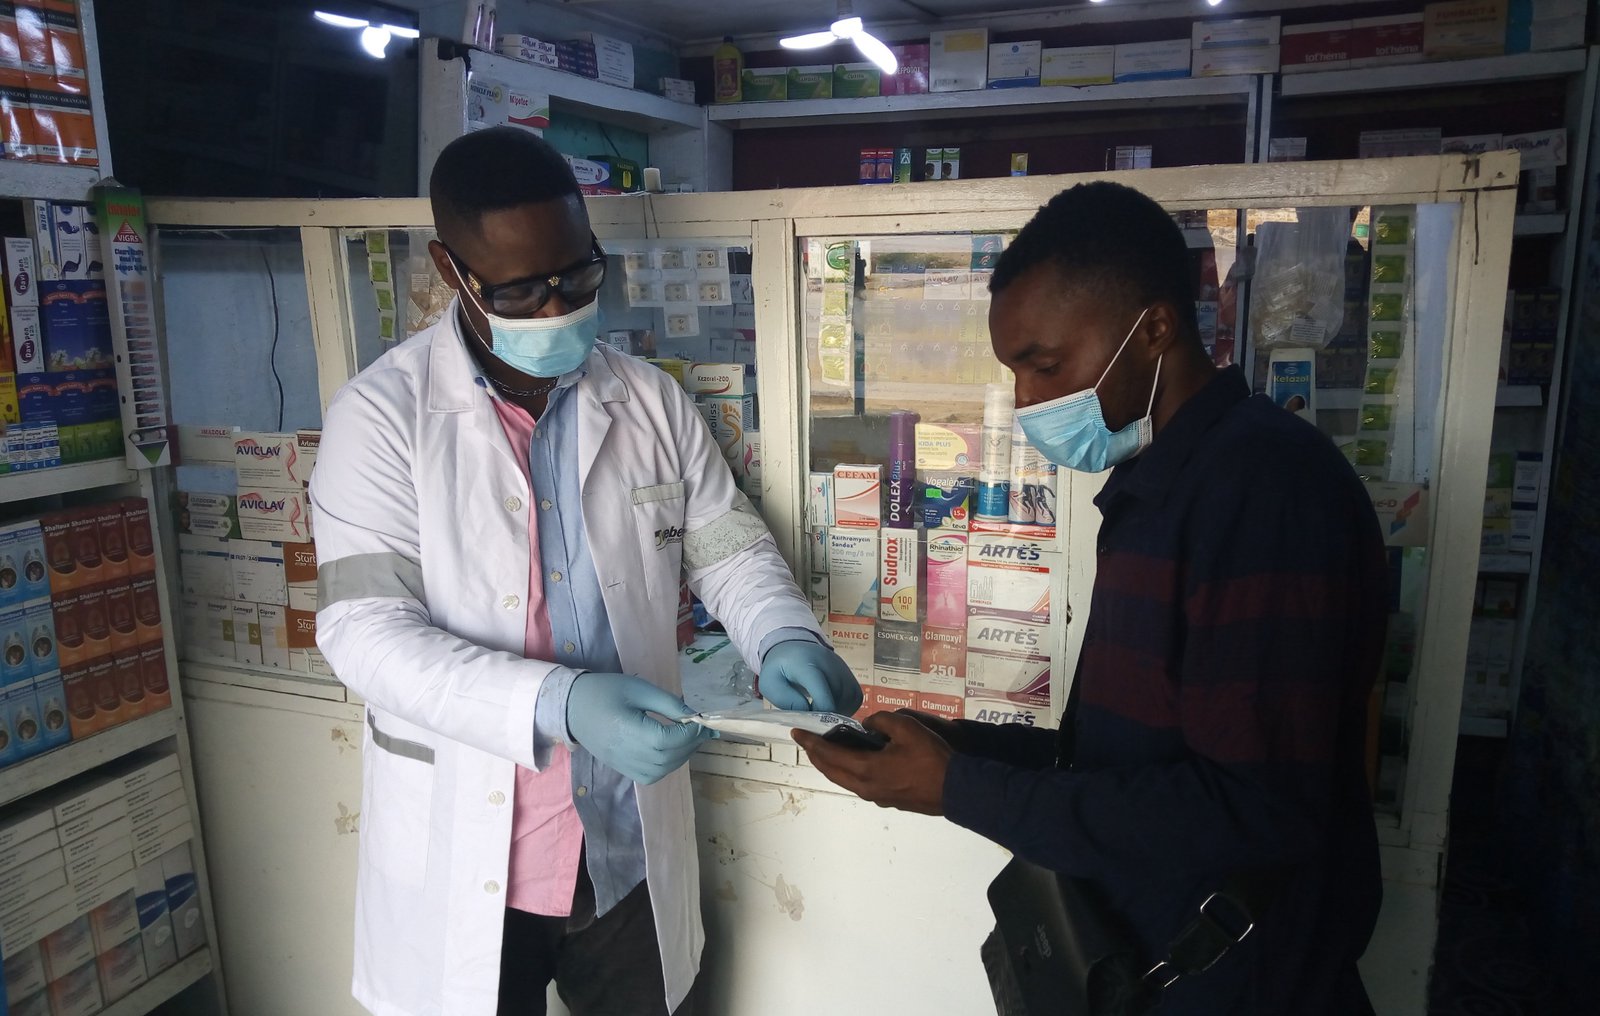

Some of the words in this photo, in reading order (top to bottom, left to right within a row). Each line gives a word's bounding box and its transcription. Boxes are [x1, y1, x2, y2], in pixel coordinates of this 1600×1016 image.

[237, 444, 282, 457] AVICLAV
[837, 471, 877, 479] CEFAM
[240, 498, 285, 511] AVICLAV
[890, 480, 901, 521] DOLEX
[930, 544, 964, 553] Rhinathiol
[884, 537, 898, 586] Sudrox
[898, 596, 912, 605] 100
[832, 630, 869, 640] PANTEC
[925, 631, 962, 644] Clamoxyl
[930, 664, 956, 677] 250
[877, 694, 912, 707] Clamoxyl
[922, 700, 958, 714] Clamoxyl
